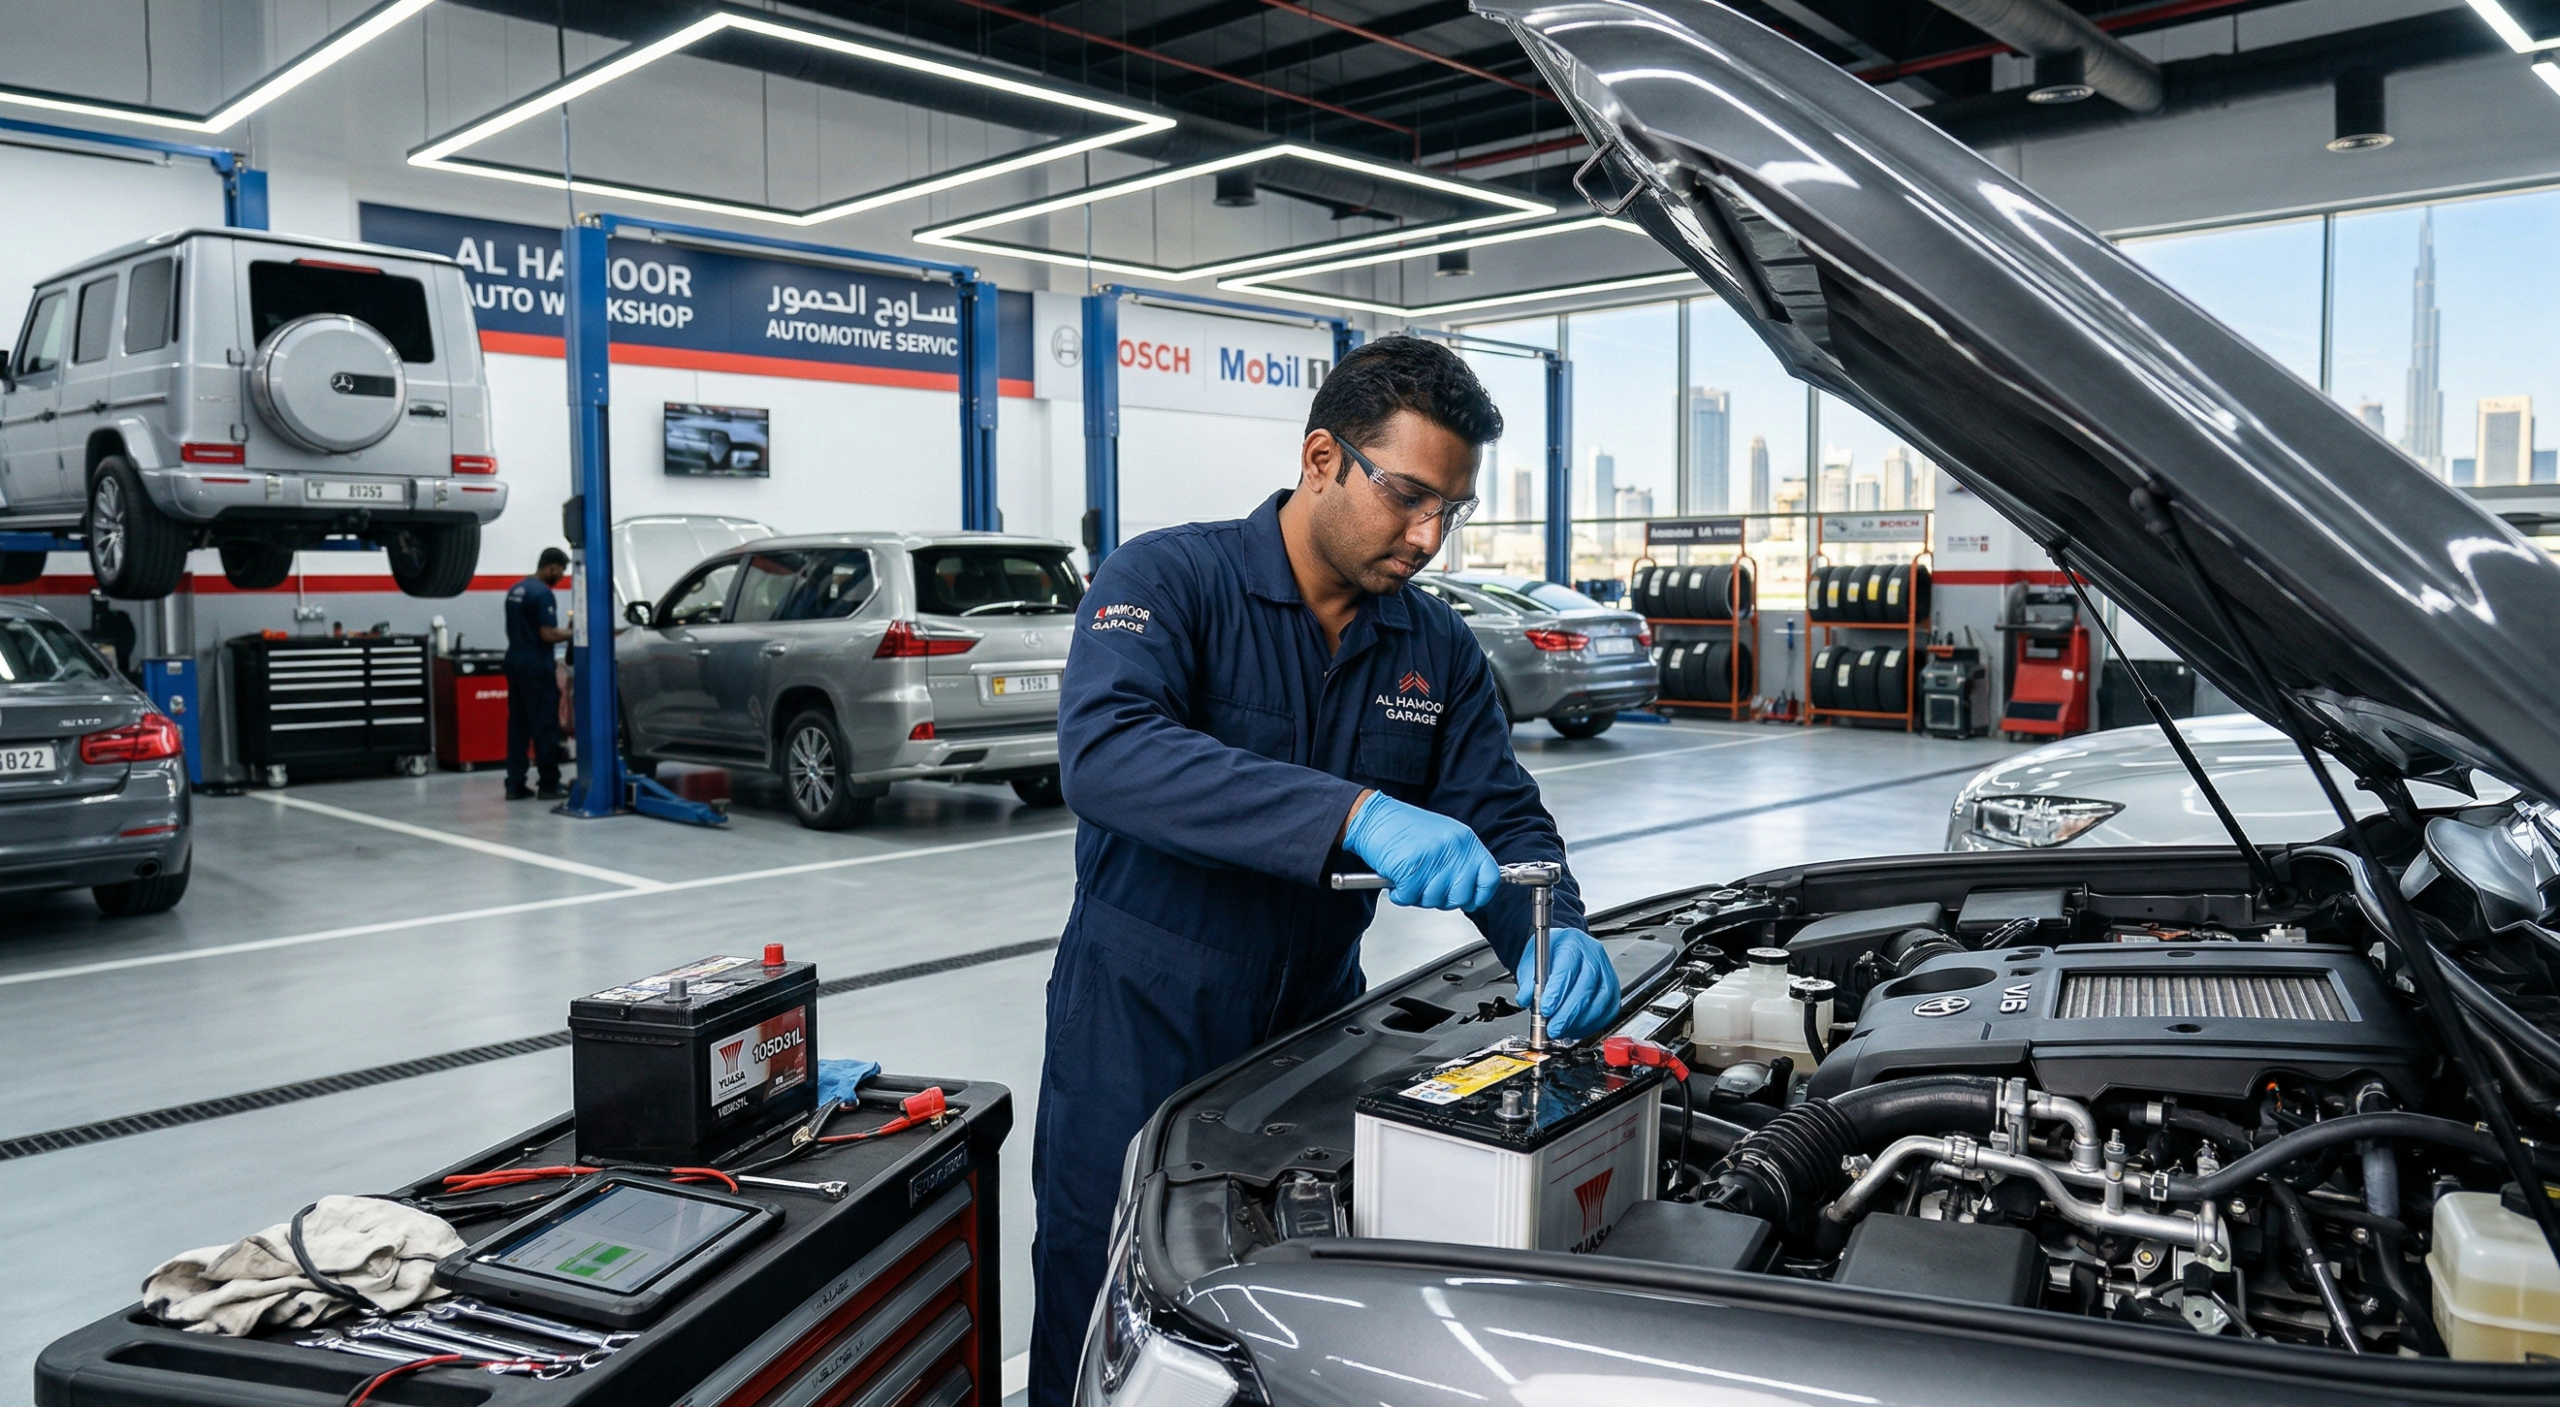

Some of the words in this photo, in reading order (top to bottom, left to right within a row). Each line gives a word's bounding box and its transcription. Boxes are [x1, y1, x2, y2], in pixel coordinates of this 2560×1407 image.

[455, 237, 508, 276] AL
[518, 244, 692, 298] HAOOR
[540, 289, 694, 329] WKSHOP
[766, 318, 892, 350] AUTOMOTIVE
[895, 332, 958, 356] SERVIC
[1118, 339, 1191, 374] OSCH
[1220, 347, 1299, 387] Mobil
[1375, 694, 1394, 706] AL
[1385, 708, 1437, 726] GARAGE
[752, 1026, 804, 1064] 105D31L
